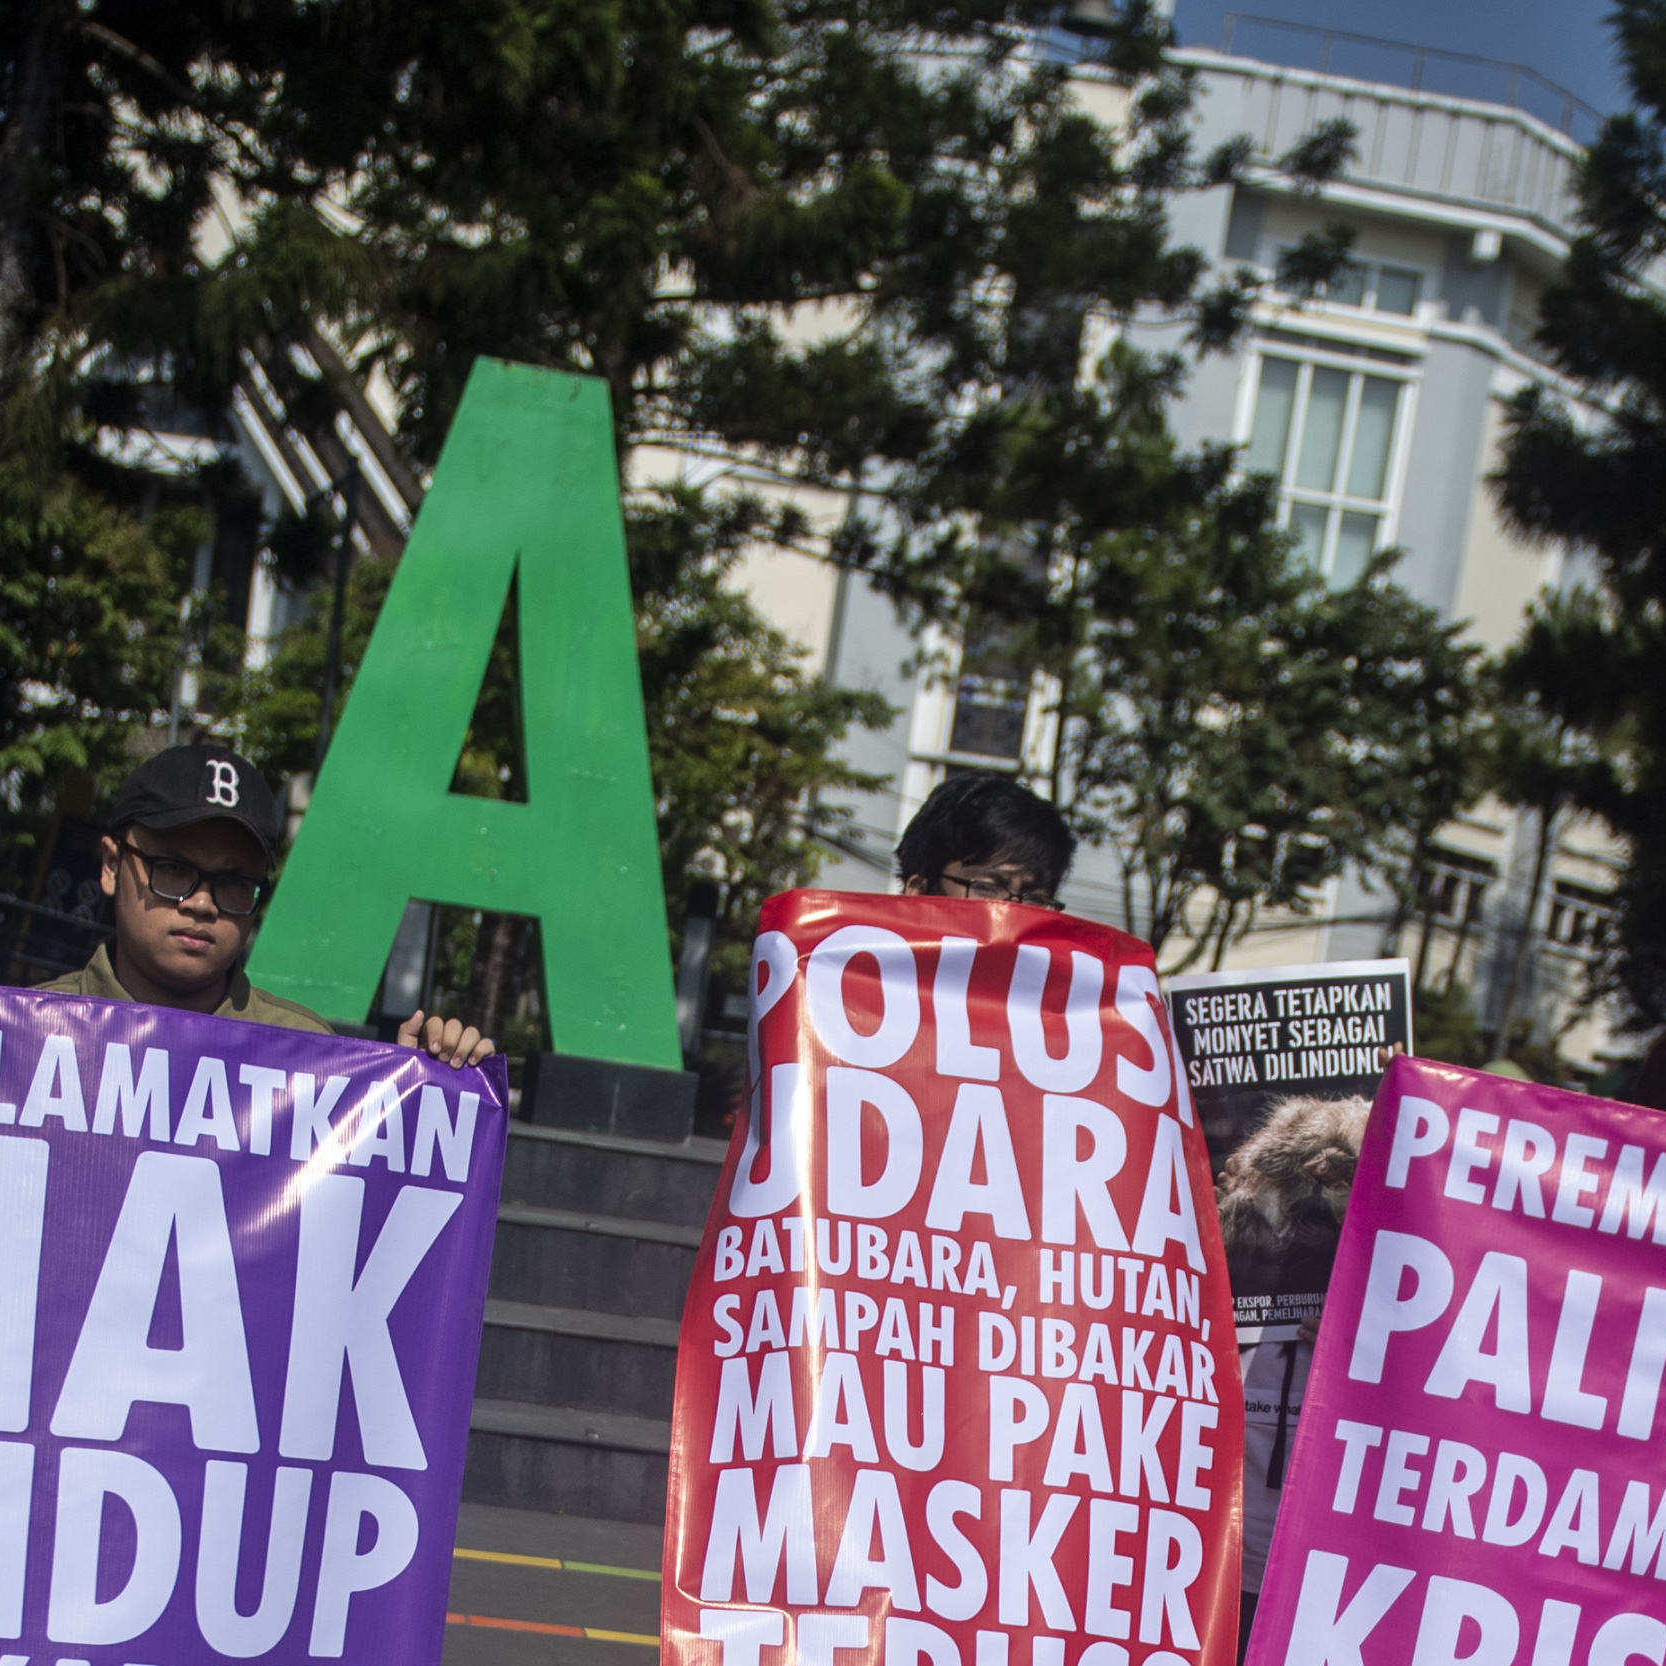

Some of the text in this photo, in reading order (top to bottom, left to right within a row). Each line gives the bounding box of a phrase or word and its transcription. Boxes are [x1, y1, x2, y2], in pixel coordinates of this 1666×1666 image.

[243, 356, 684, 1072] A
[205, 759, 240, 807] B
[1185, 982, 1391, 1025] SEGERA TETAPKAN
[1193, 1015, 1385, 1056] MONYET SEBAGAI
[1189, 1055, 1258, 1087] SATWA
[728, 1062, 1207, 1275] UDARA
[714, 1218, 1212, 1342] BATUBARA, HUTAN,
[713, 1287, 1220, 1404] SAMPAH DIBAKAR
[709, 1355, 1221, 1511] MAU PAKE
[699, 1467, 1204, 1651] MASKER
